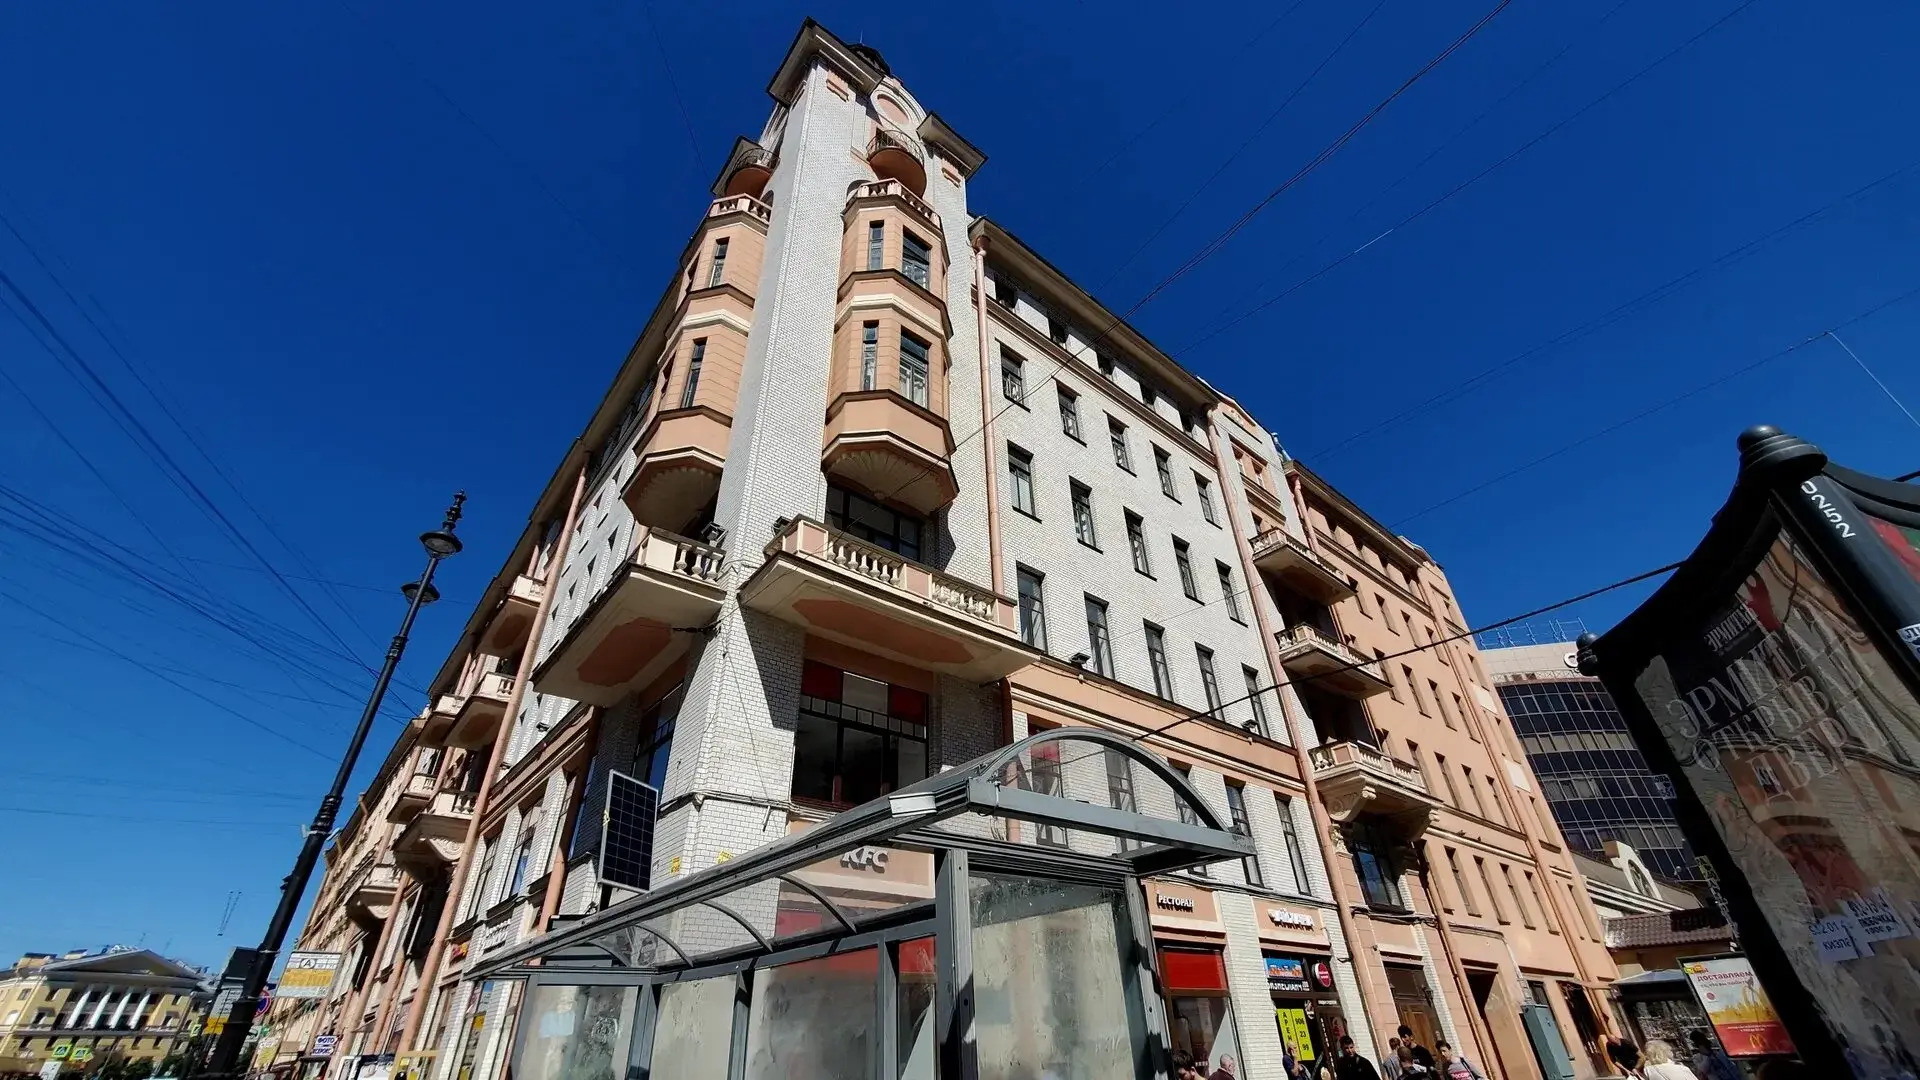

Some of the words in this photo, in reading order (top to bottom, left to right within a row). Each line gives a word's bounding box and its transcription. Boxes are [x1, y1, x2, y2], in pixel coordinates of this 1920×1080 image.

[842, 845, 888, 868] KFC
[1158, 895, 1194, 908] РЕСТОРАН
[1697, 971, 1754, 982] доставляем
